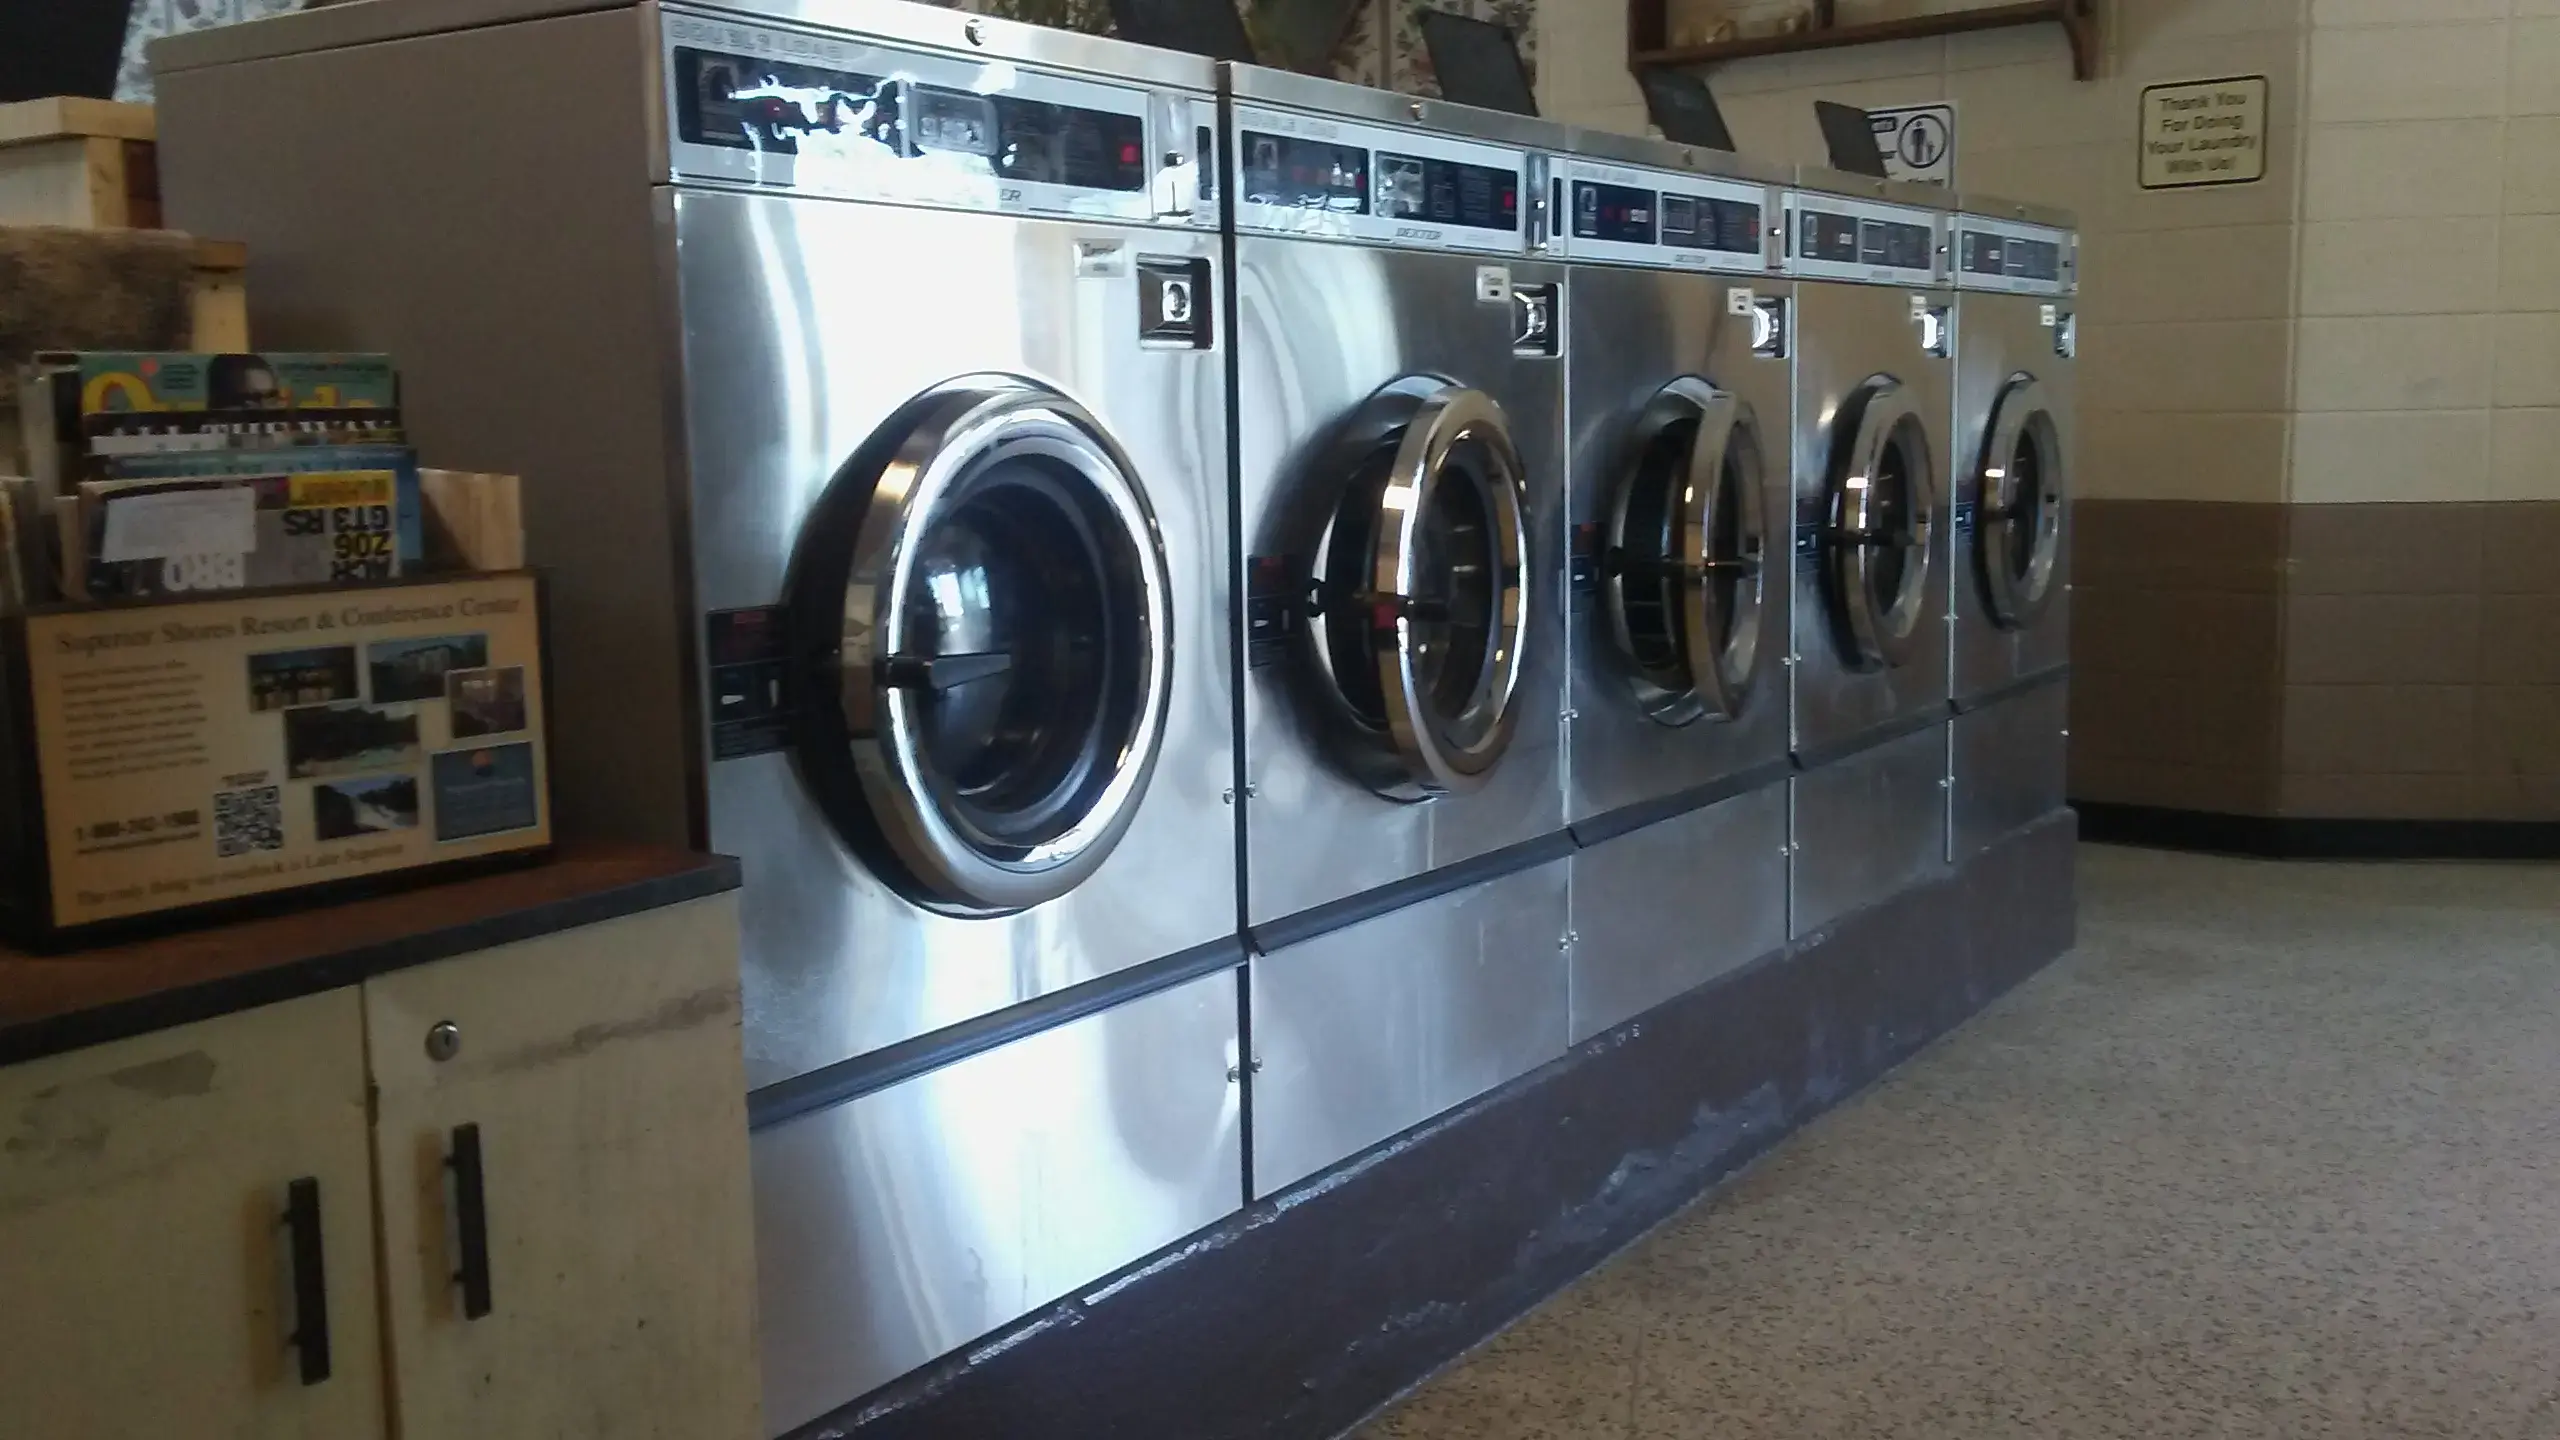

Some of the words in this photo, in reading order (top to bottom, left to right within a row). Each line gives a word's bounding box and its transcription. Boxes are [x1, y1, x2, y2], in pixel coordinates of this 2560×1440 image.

[2158, 95, 2208, 111] Thank
[2216, 92, 2248, 106] You
[2161, 118, 2189, 133] For
[2194, 115, 2244, 131] Doing
[2145, 140, 2185, 155] Your
[2189, 134, 2257, 152] Laundry
[2164, 159, 2204, 175] With
[281, 508, 324, 537] RS
[332, 505, 390, 534] GT3
[56, 622, 153, 657] Superior
[161, 616, 236, 646] Shores
[241, 612, 311, 638] Resort
[316, 610, 334, 631] &
[341, 601, 454, 629] Conference
[458, 595, 521, 618] Center
